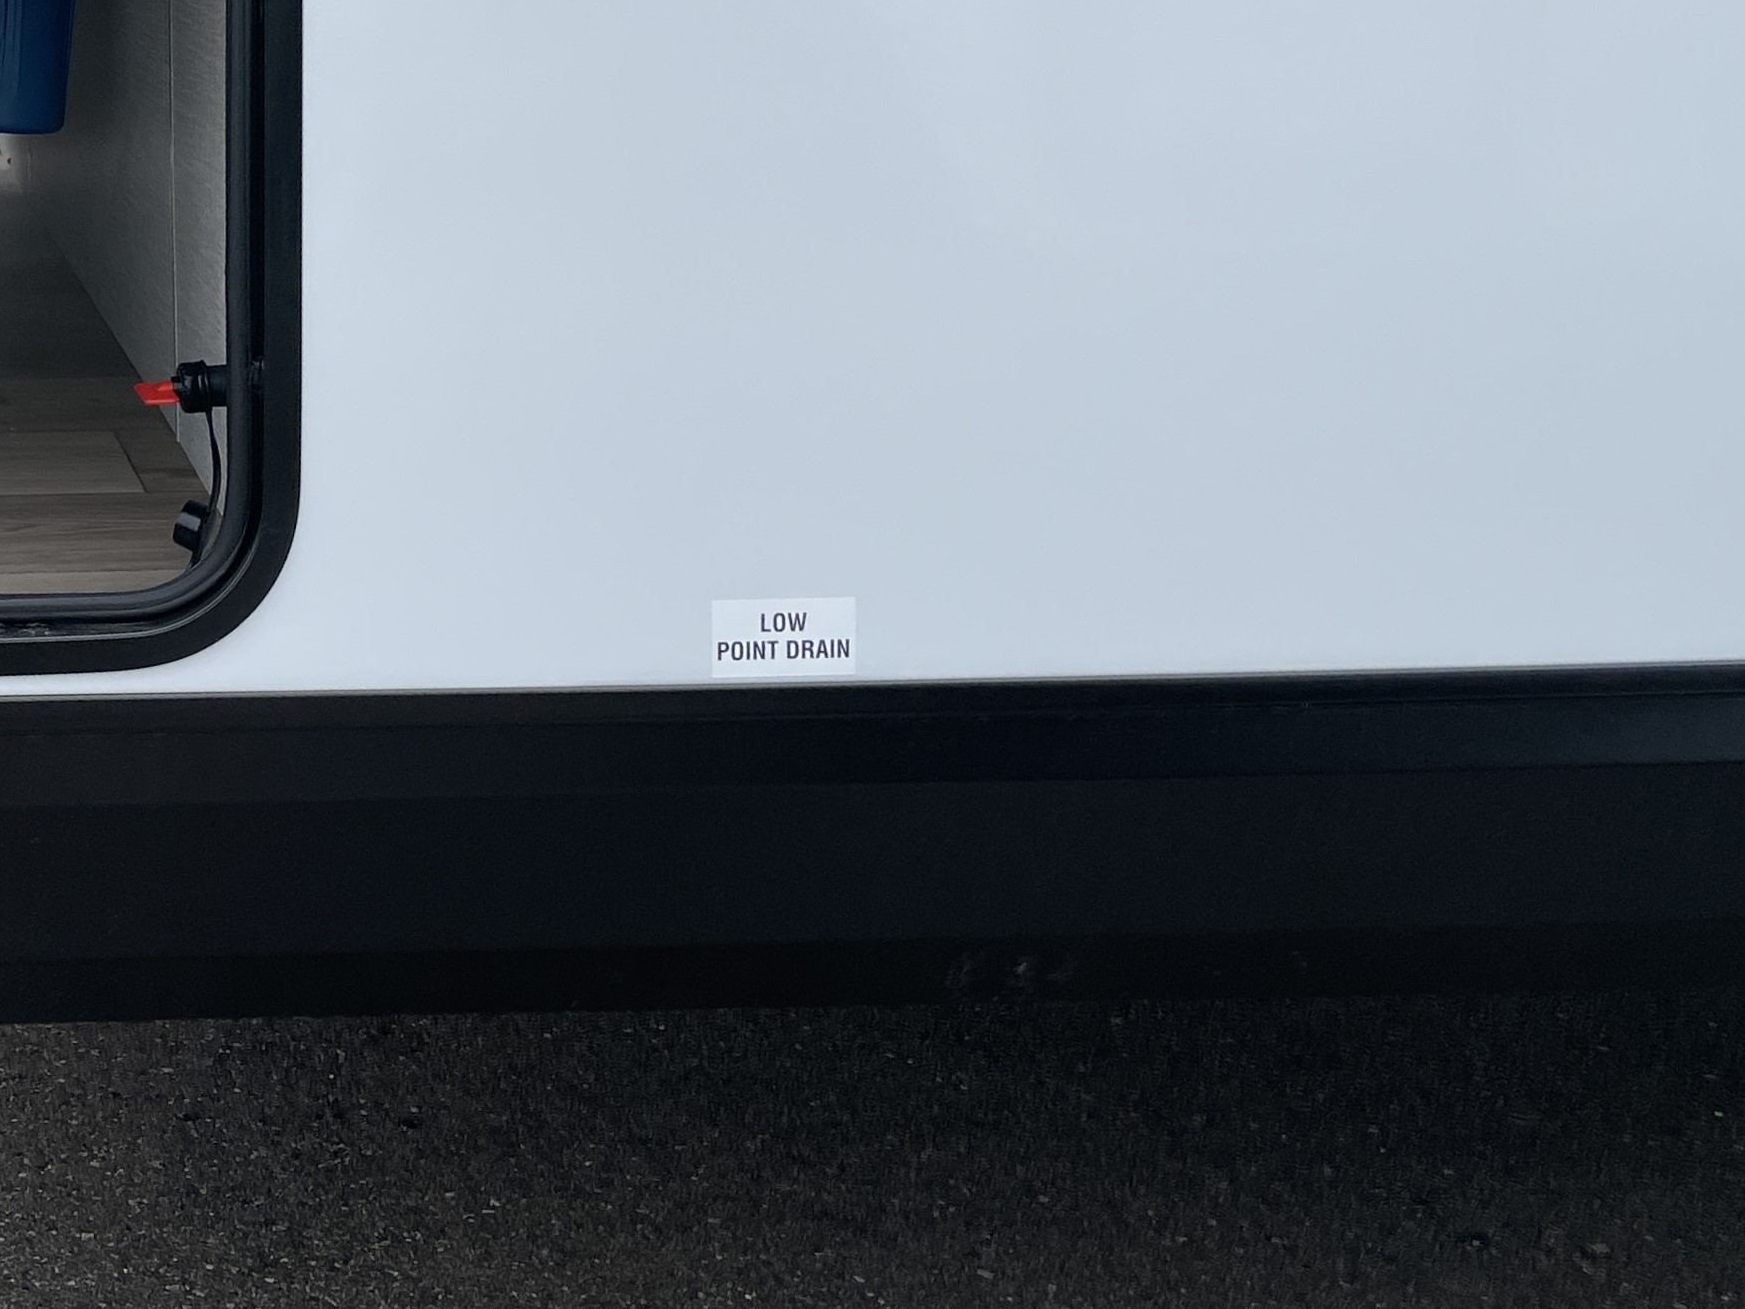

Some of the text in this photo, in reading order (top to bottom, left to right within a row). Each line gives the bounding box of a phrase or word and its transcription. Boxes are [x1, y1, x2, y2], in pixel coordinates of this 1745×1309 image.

[760, 612, 807, 633] LOW
[717, 638, 850, 661] POINT DRAIN
